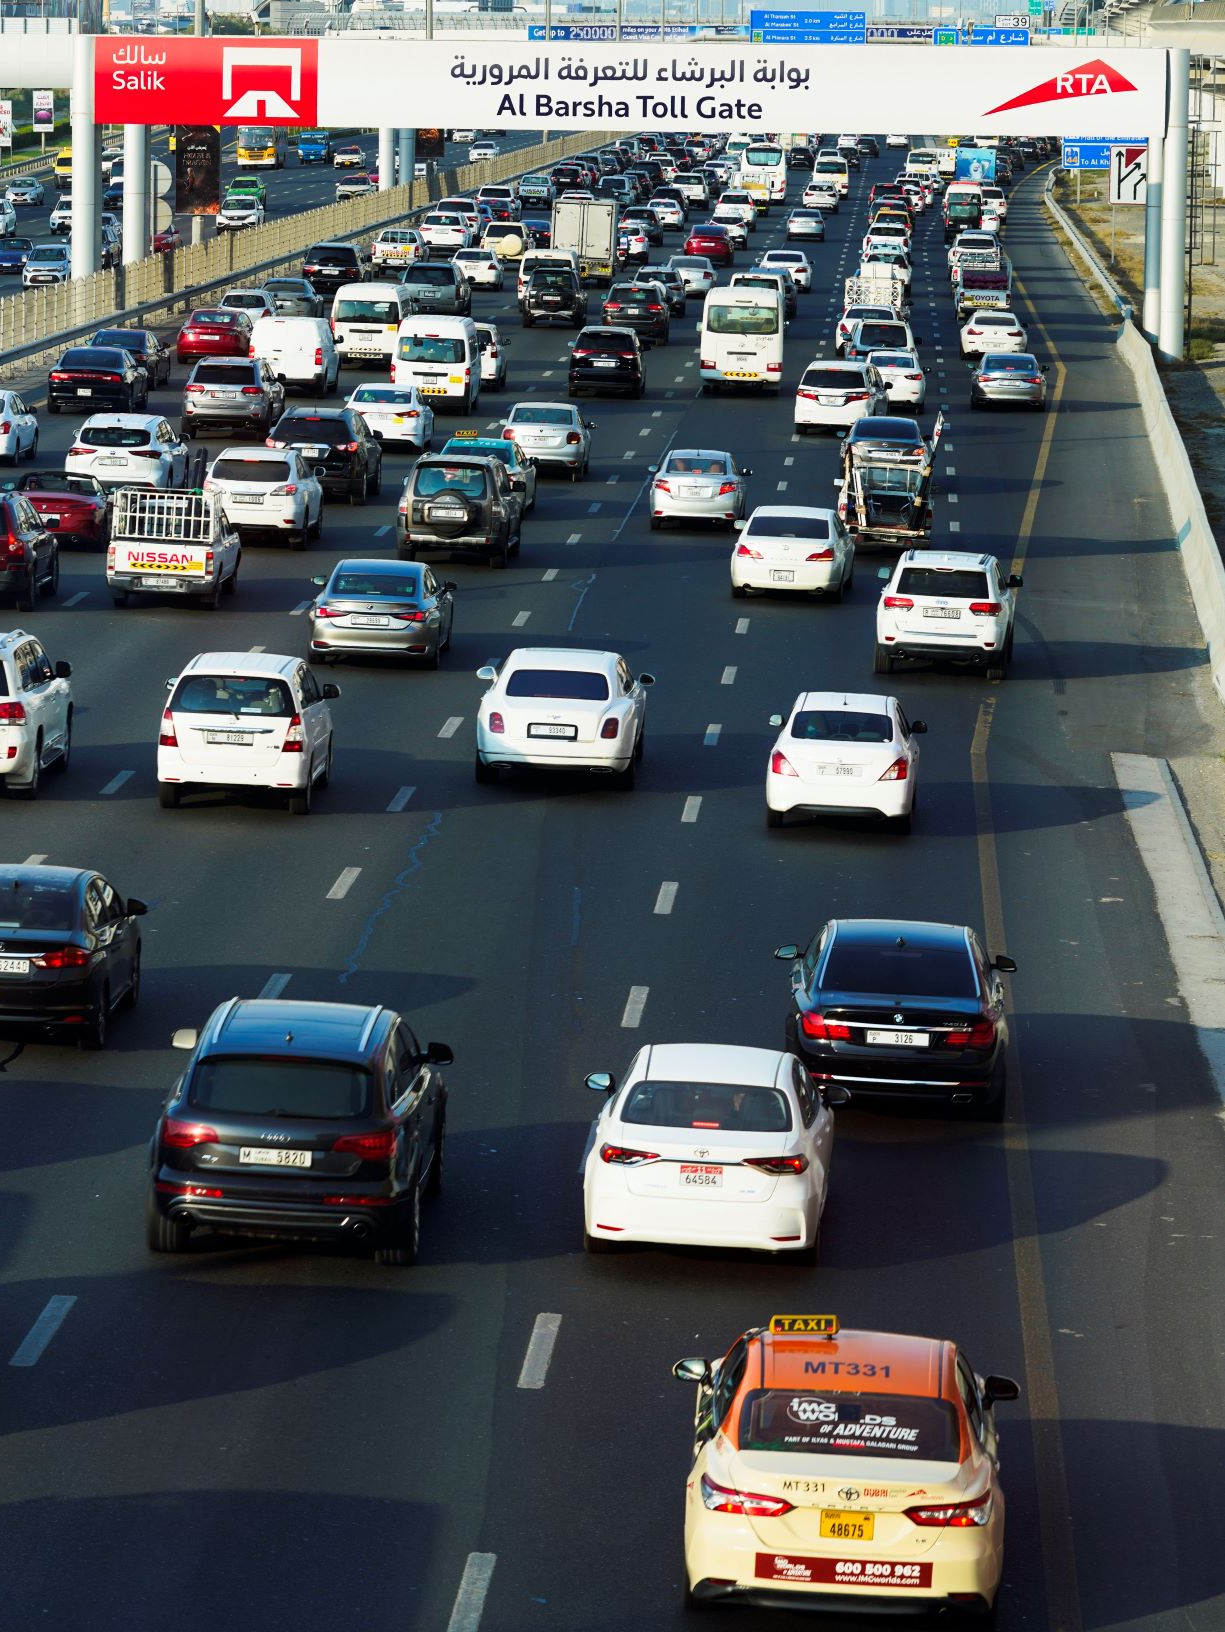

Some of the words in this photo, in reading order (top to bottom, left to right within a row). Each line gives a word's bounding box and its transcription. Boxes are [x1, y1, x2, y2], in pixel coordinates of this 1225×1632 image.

[1012, 17, 1027, 27] 39
[557, 28, 566, 37] to
[999, 32, 1025, 43] شارع
[112, 45, 166, 65] سالك
[112, 70, 166, 91] Salik
[449, 55, 550, 89] المرورية
[556, 55, 649, 90] للتعرفة
[655, 56, 745, 90] البرشاء
[752, 58, 812, 90] بوابة
[1056, 73, 1113, 95] RTA
[496, 93, 527, 117] Al
[535, 93, 631, 118] Barsha
[636, 94, 689, 119] Toll
[695, 95, 763, 120] Gate
[128, 552, 193, 565] NISSAN
[894, 1033, 914, 1044] 3126
[242, 1148, 251, 1160] M
[276, 1149, 307, 1166] 5820
[685, 1174, 717, 1185] 64584
[781, 1319, 827, 1332] TAXI
[803, 1360, 892, 1379] MT331
[819, 1424, 833, 1434] OF
[833, 1423, 920, 1442] ADVENTURE
[782, 1480, 799, 1491] MT
[803, 1481, 825, 1493] 331
[829, 1523, 864, 1538] 48675
[835, 1561, 862, 1575] 600
[865, 1562, 892, 1576] 500
[894, 1563, 921, 1577] 962
